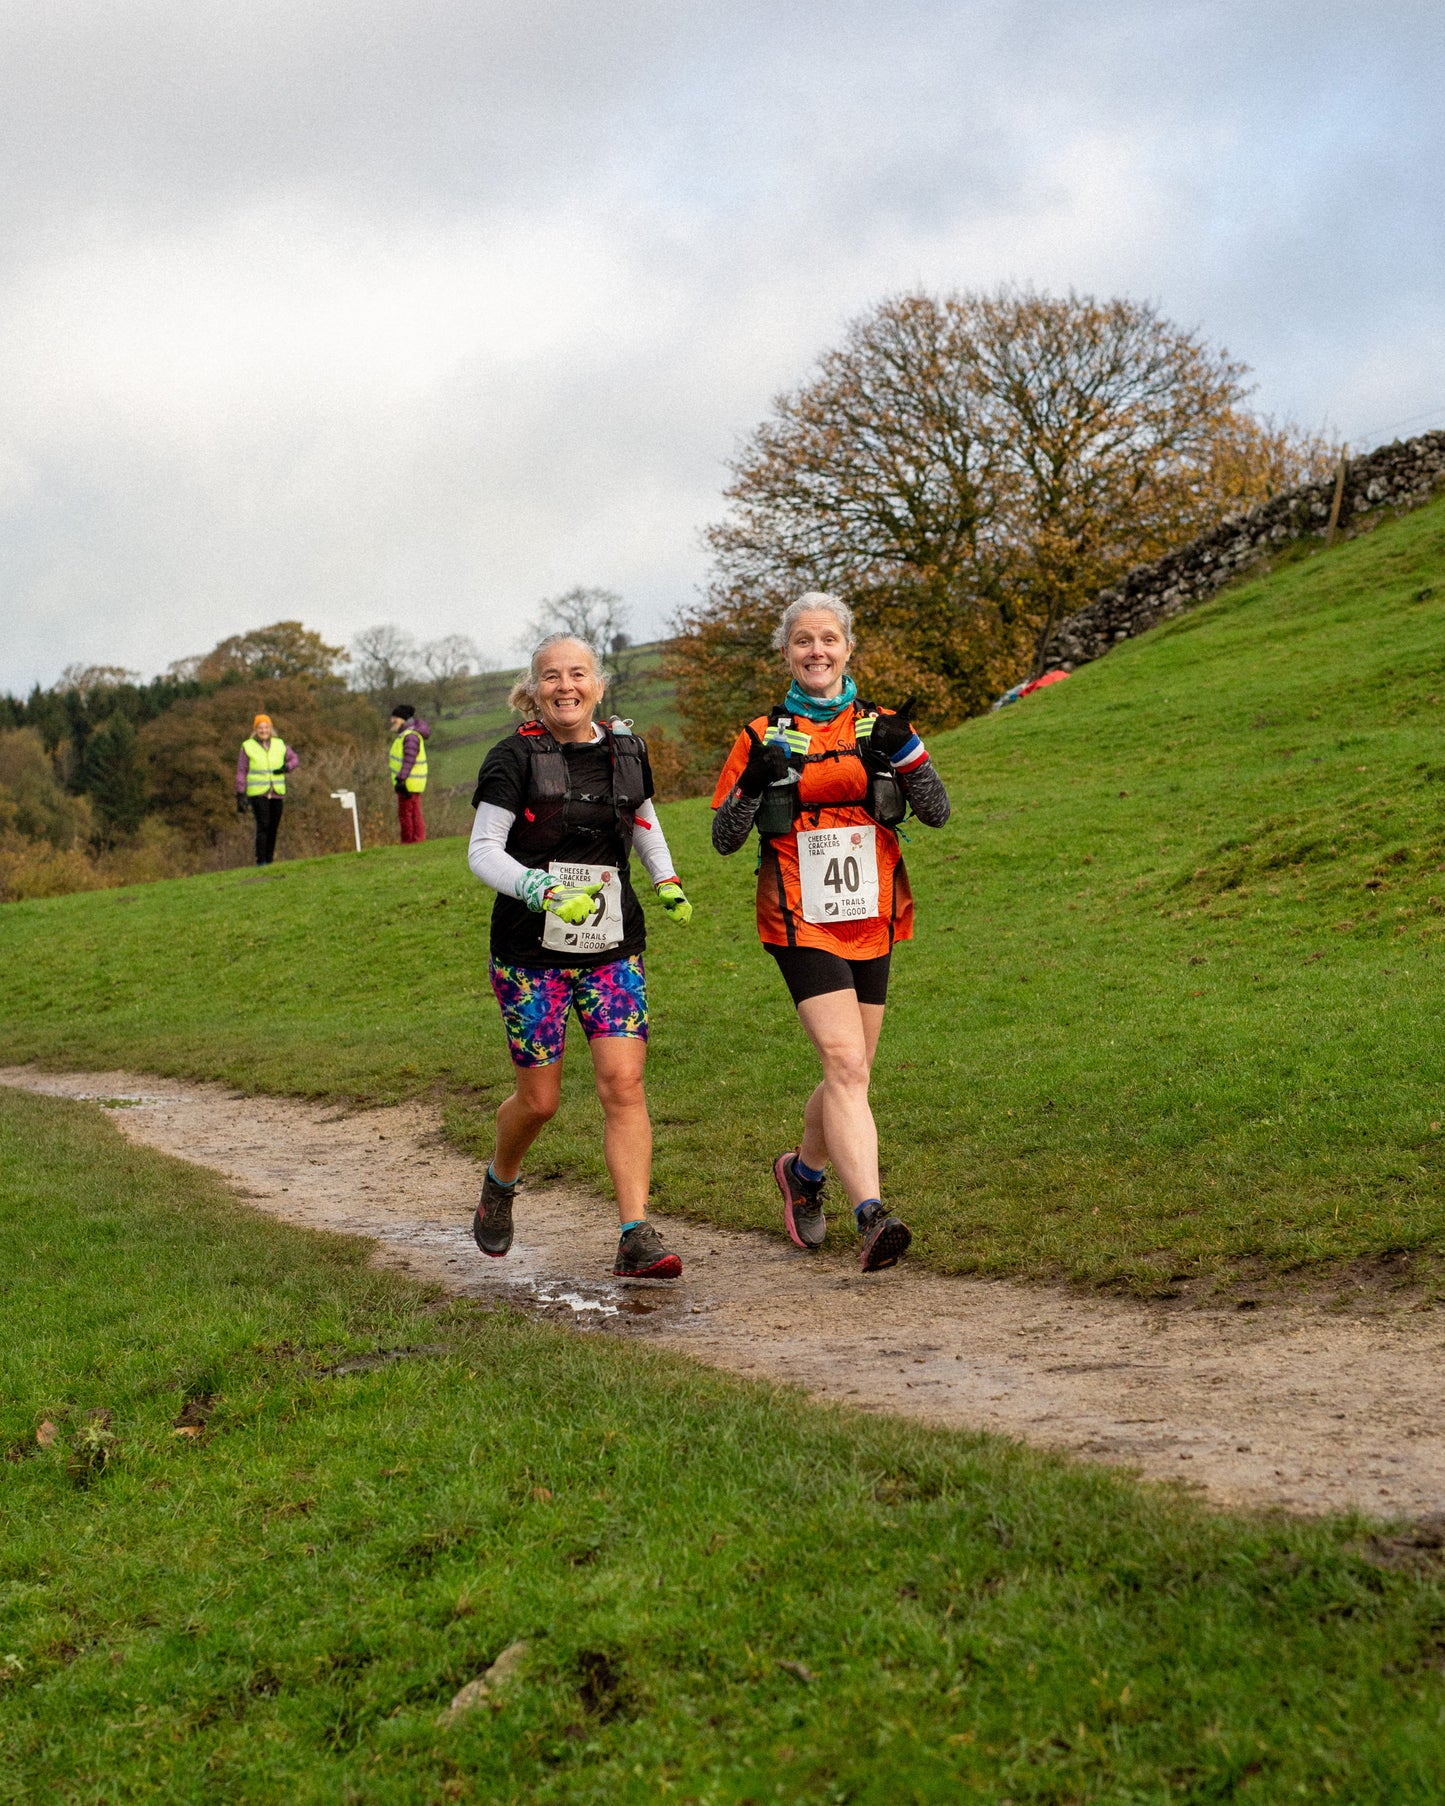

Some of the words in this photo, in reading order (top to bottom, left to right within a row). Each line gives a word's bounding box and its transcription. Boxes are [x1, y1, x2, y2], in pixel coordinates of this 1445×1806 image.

[837, 740, 856, 751] Sw
[808, 834, 832, 843] CHEESE
[808, 841, 840, 849] CRACKERS
[560, 867, 584, 875] CHEESE
[823, 855, 860, 893] 40
[559, 874, 591, 882] CRACKERS
[841, 898, 866, 906] TRAILS
[570, 892, 606, 927] 9
[846, 907, 867, 916] GOOD
[581, 932, 607, 941] TRAILS
[583, 941, 606, 949] GOOD
